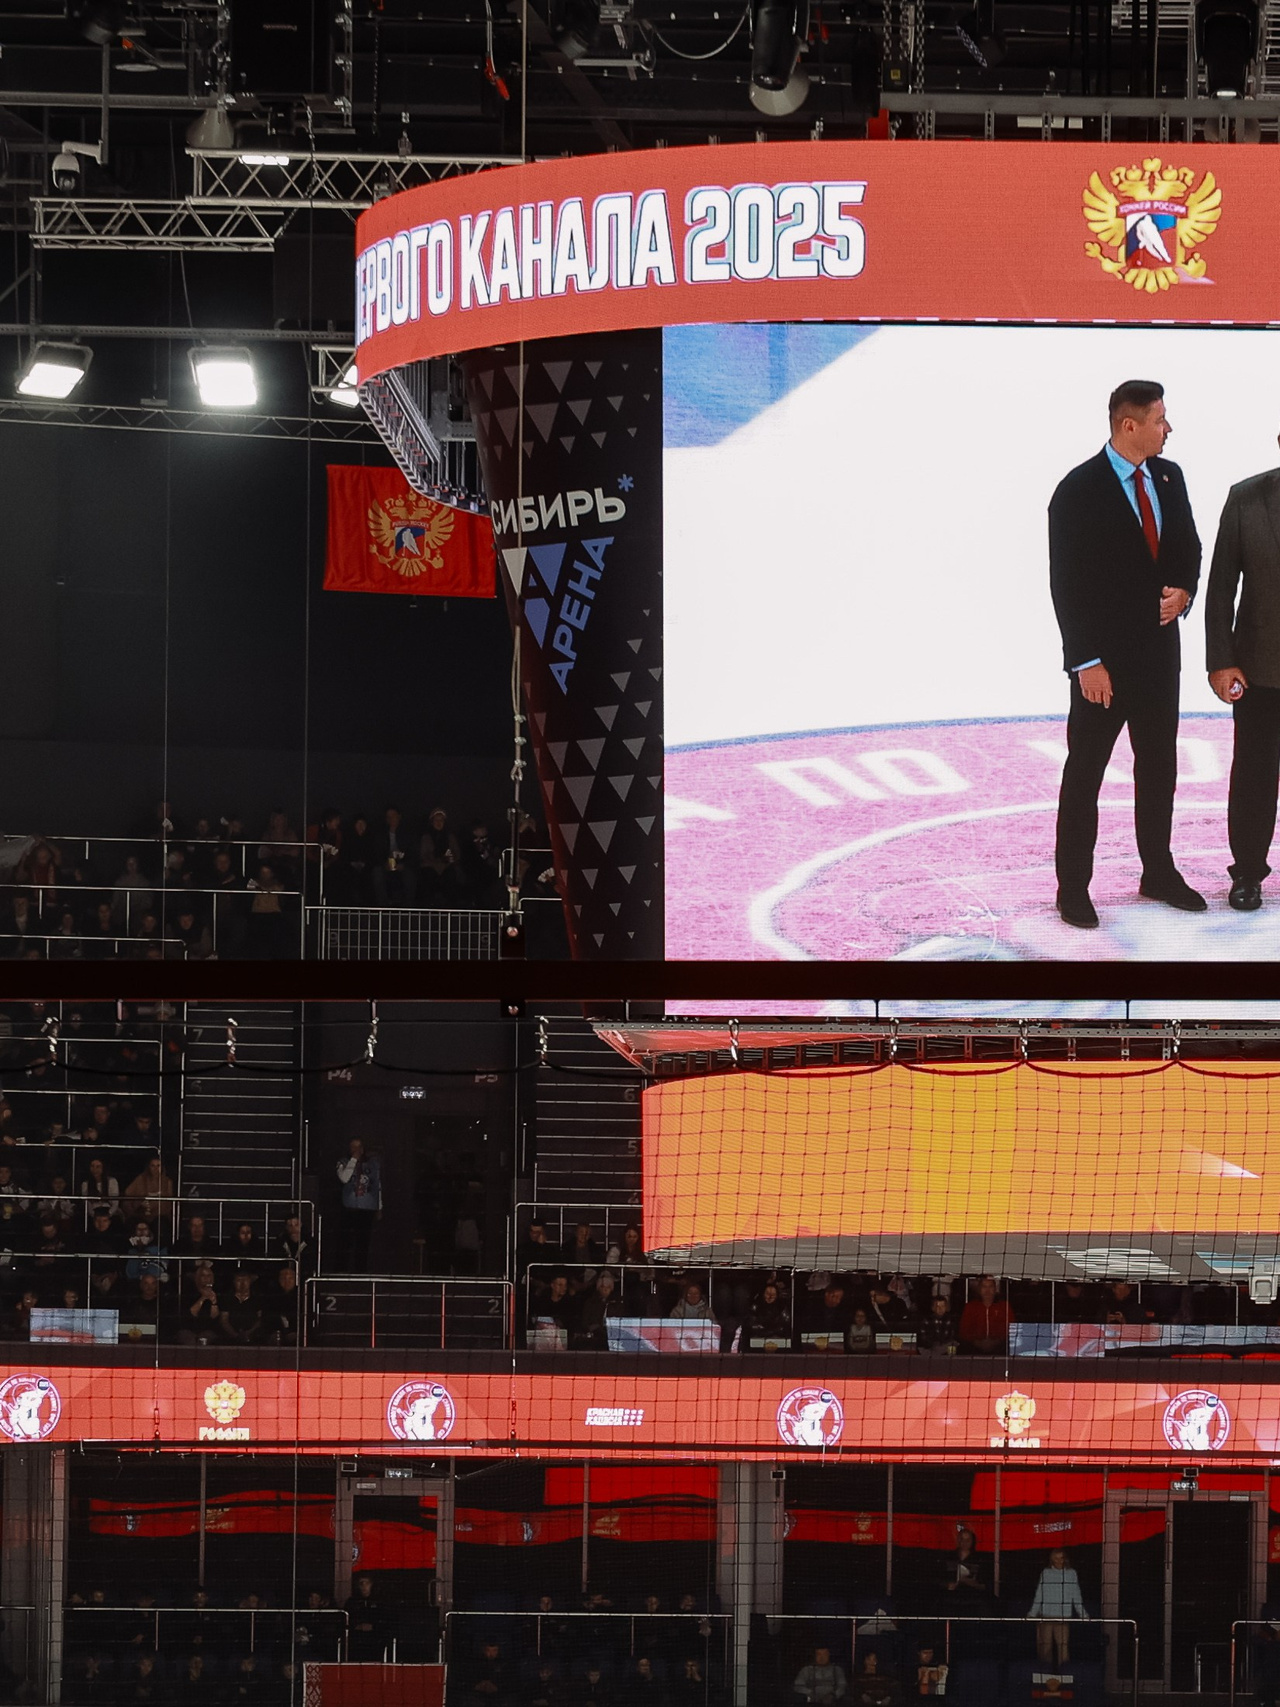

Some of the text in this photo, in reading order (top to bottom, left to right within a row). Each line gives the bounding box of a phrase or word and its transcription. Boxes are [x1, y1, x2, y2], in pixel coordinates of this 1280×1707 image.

[356, 181, 868, 348] ЕРВОГО КАНАЛА 2025
[490, 487, 627, 535] СИБИРЬ
[549, 536, 615, 696] АРЕНА
[192, 1029, 203, 1041] 7
[624, 1088, 635, 1101] 6
[189, 1133, 200, 1146] 5
[627, 1140, 638, 1154] 5
[326, 1296, 337, 1311] 2
[488, 1299, 500, 1314] 2
